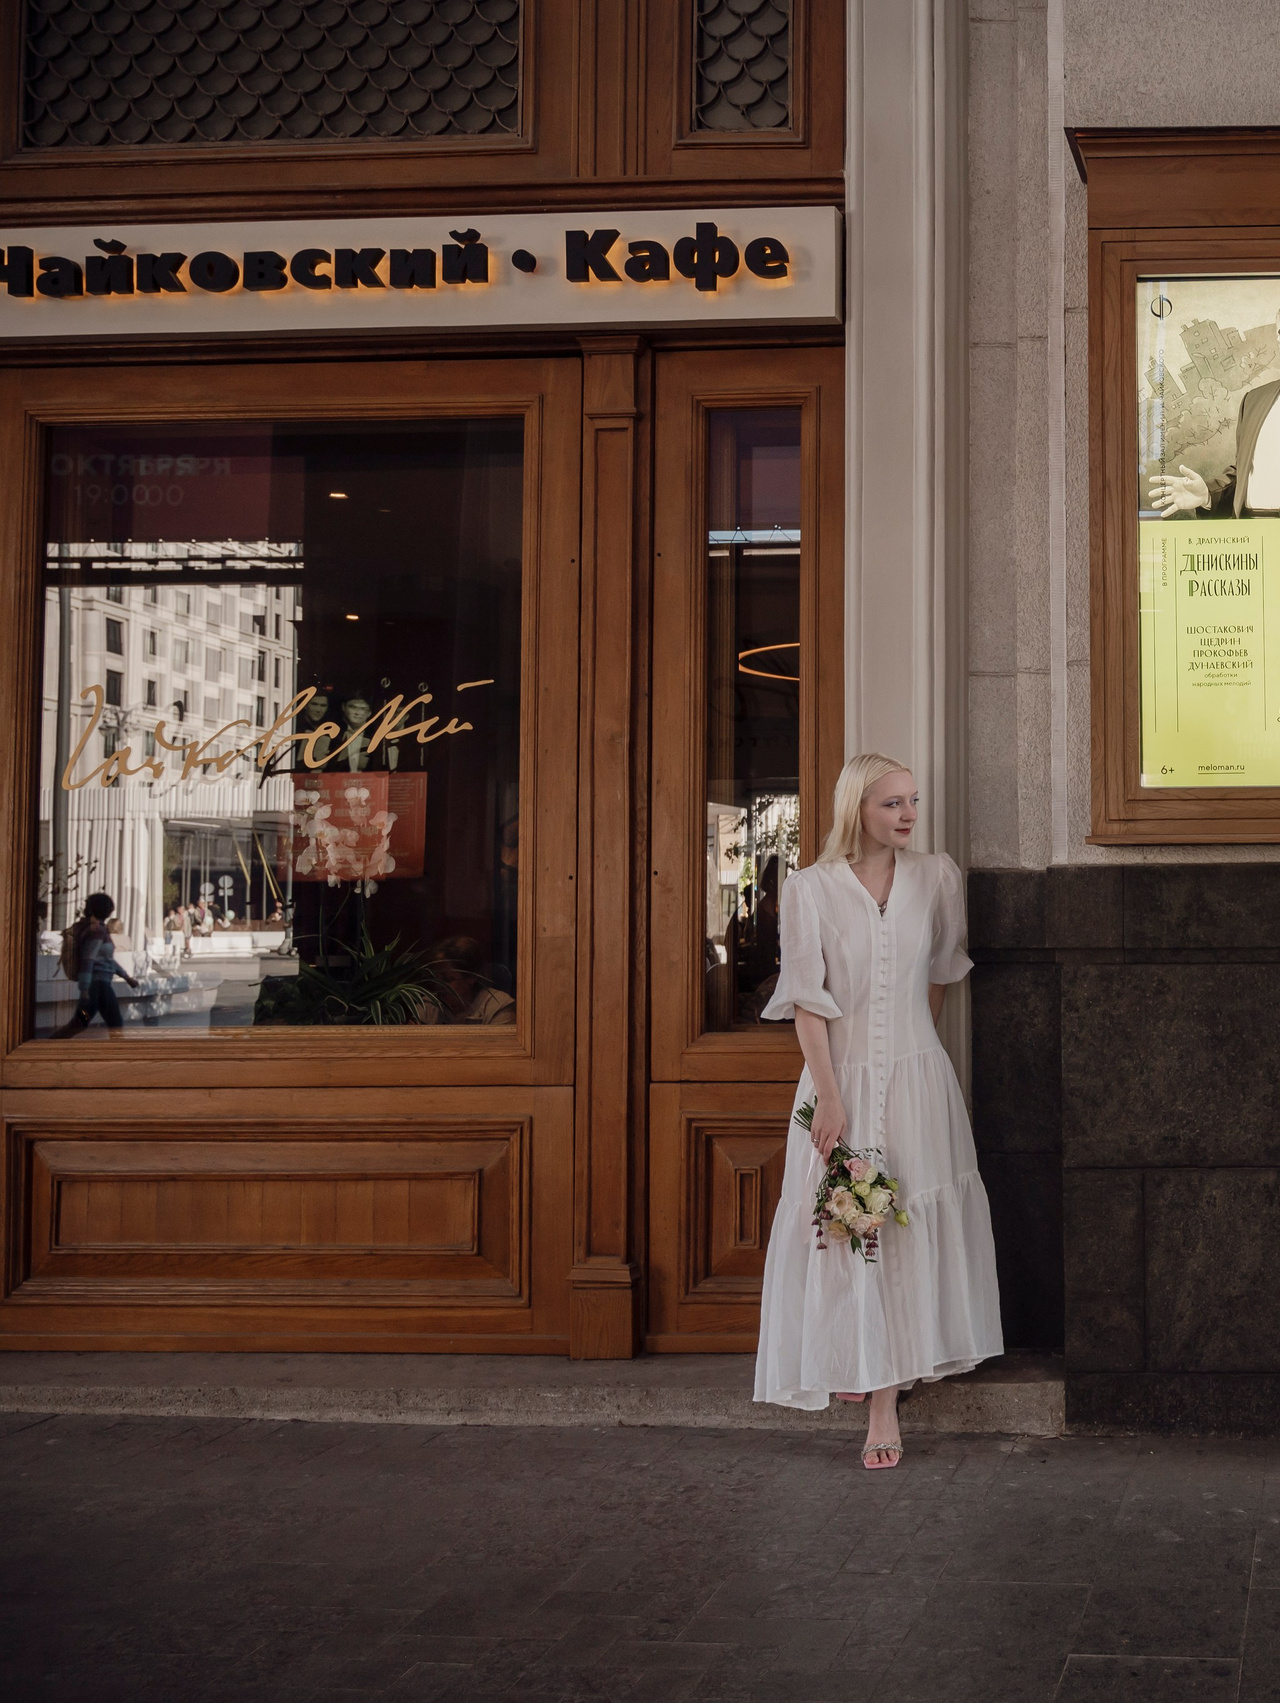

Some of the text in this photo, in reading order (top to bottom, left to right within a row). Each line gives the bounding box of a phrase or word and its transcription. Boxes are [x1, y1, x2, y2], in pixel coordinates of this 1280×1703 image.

[0, 222, 790, 298] Чайковский Кафе
[1196, 536, 1250, 545] ДРАГУНСКИЙ
[1188, 579, 1251, 597] РАССКАЗЫ
[1186, 625, 1254, 634] ШОСТАКОВИЧ
[1200, 637, 1241, 647] ЩЕДРИН
[1193, 649, 1249, 658] ПРОКОФЬЕВ
[1187, 659, 1253, 671] ДУНАЕВСКИЙ
[1160, 765, 1175, 775] 6+
